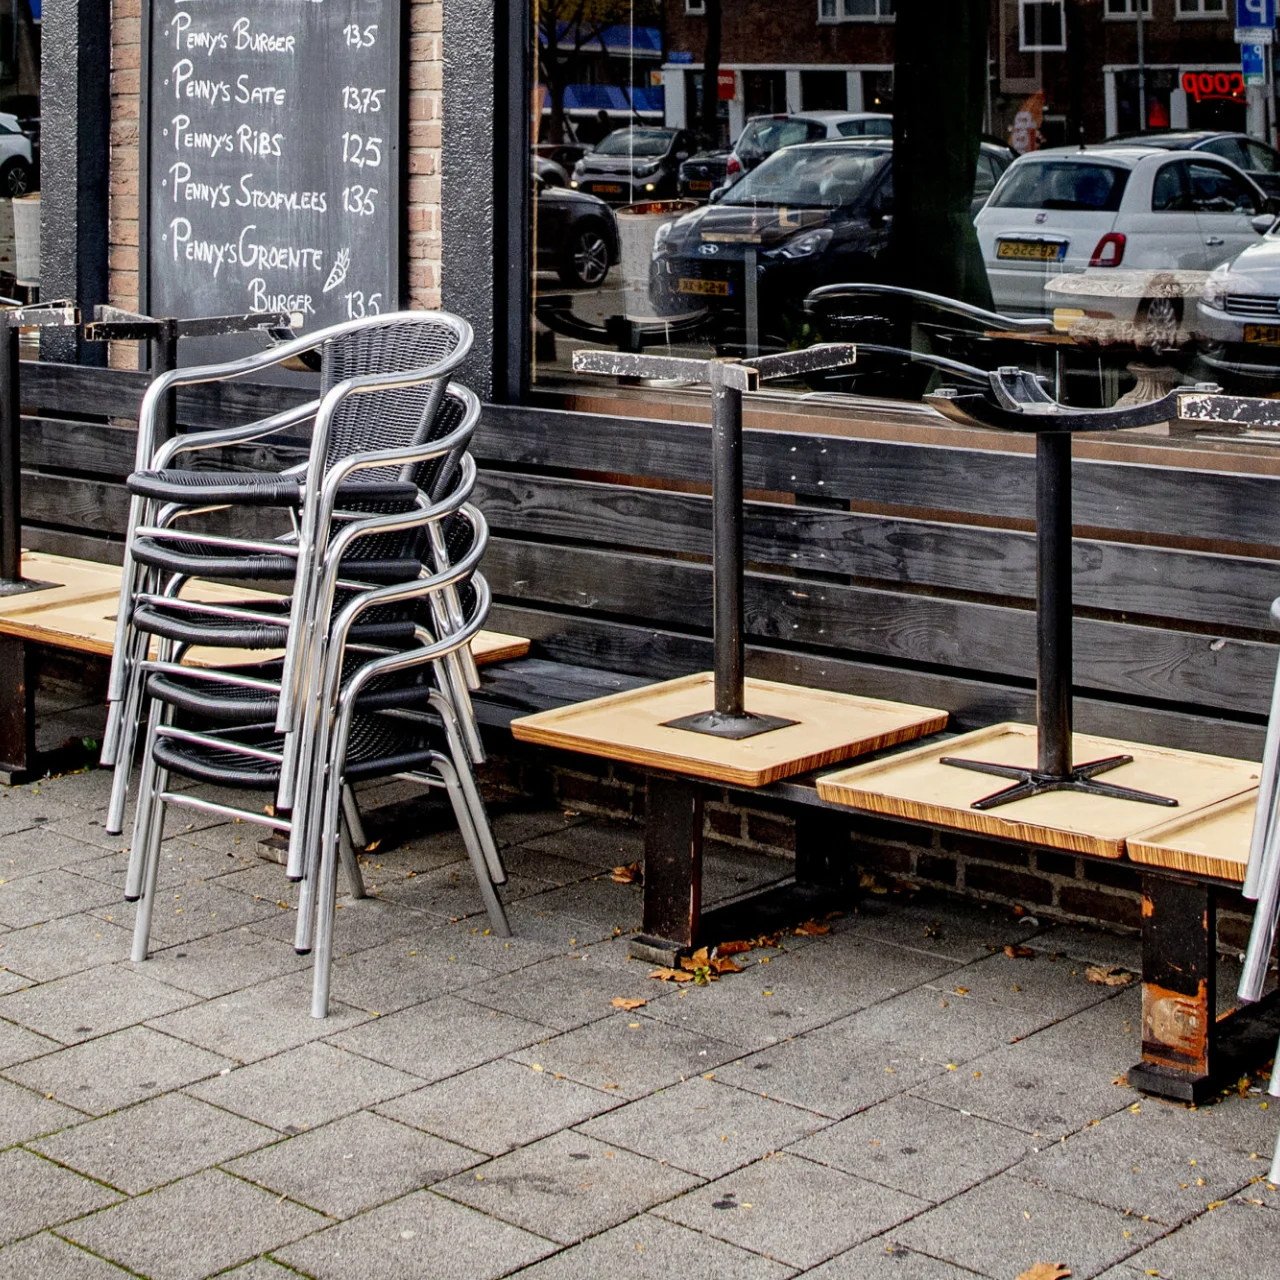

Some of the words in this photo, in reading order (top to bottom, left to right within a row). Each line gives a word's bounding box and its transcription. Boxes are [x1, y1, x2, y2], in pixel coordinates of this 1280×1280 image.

[171, 11, 228, 55] PENNY'S
[232, 17, 295, 53] BURGER
[172, 58, 231, 105] PENNY'S
[235, 74, 287, 106] SATE
[171, 114, 234, 159] PENNY'S
[237, 125, 282, 158] RIBS
[169, 161, 231, 210] PENNY'S
[169, 216, 238, 279] PENNY'S
[238, 224, 323, 271] GROENTE
[247, 276, 317, 315] BURGER
